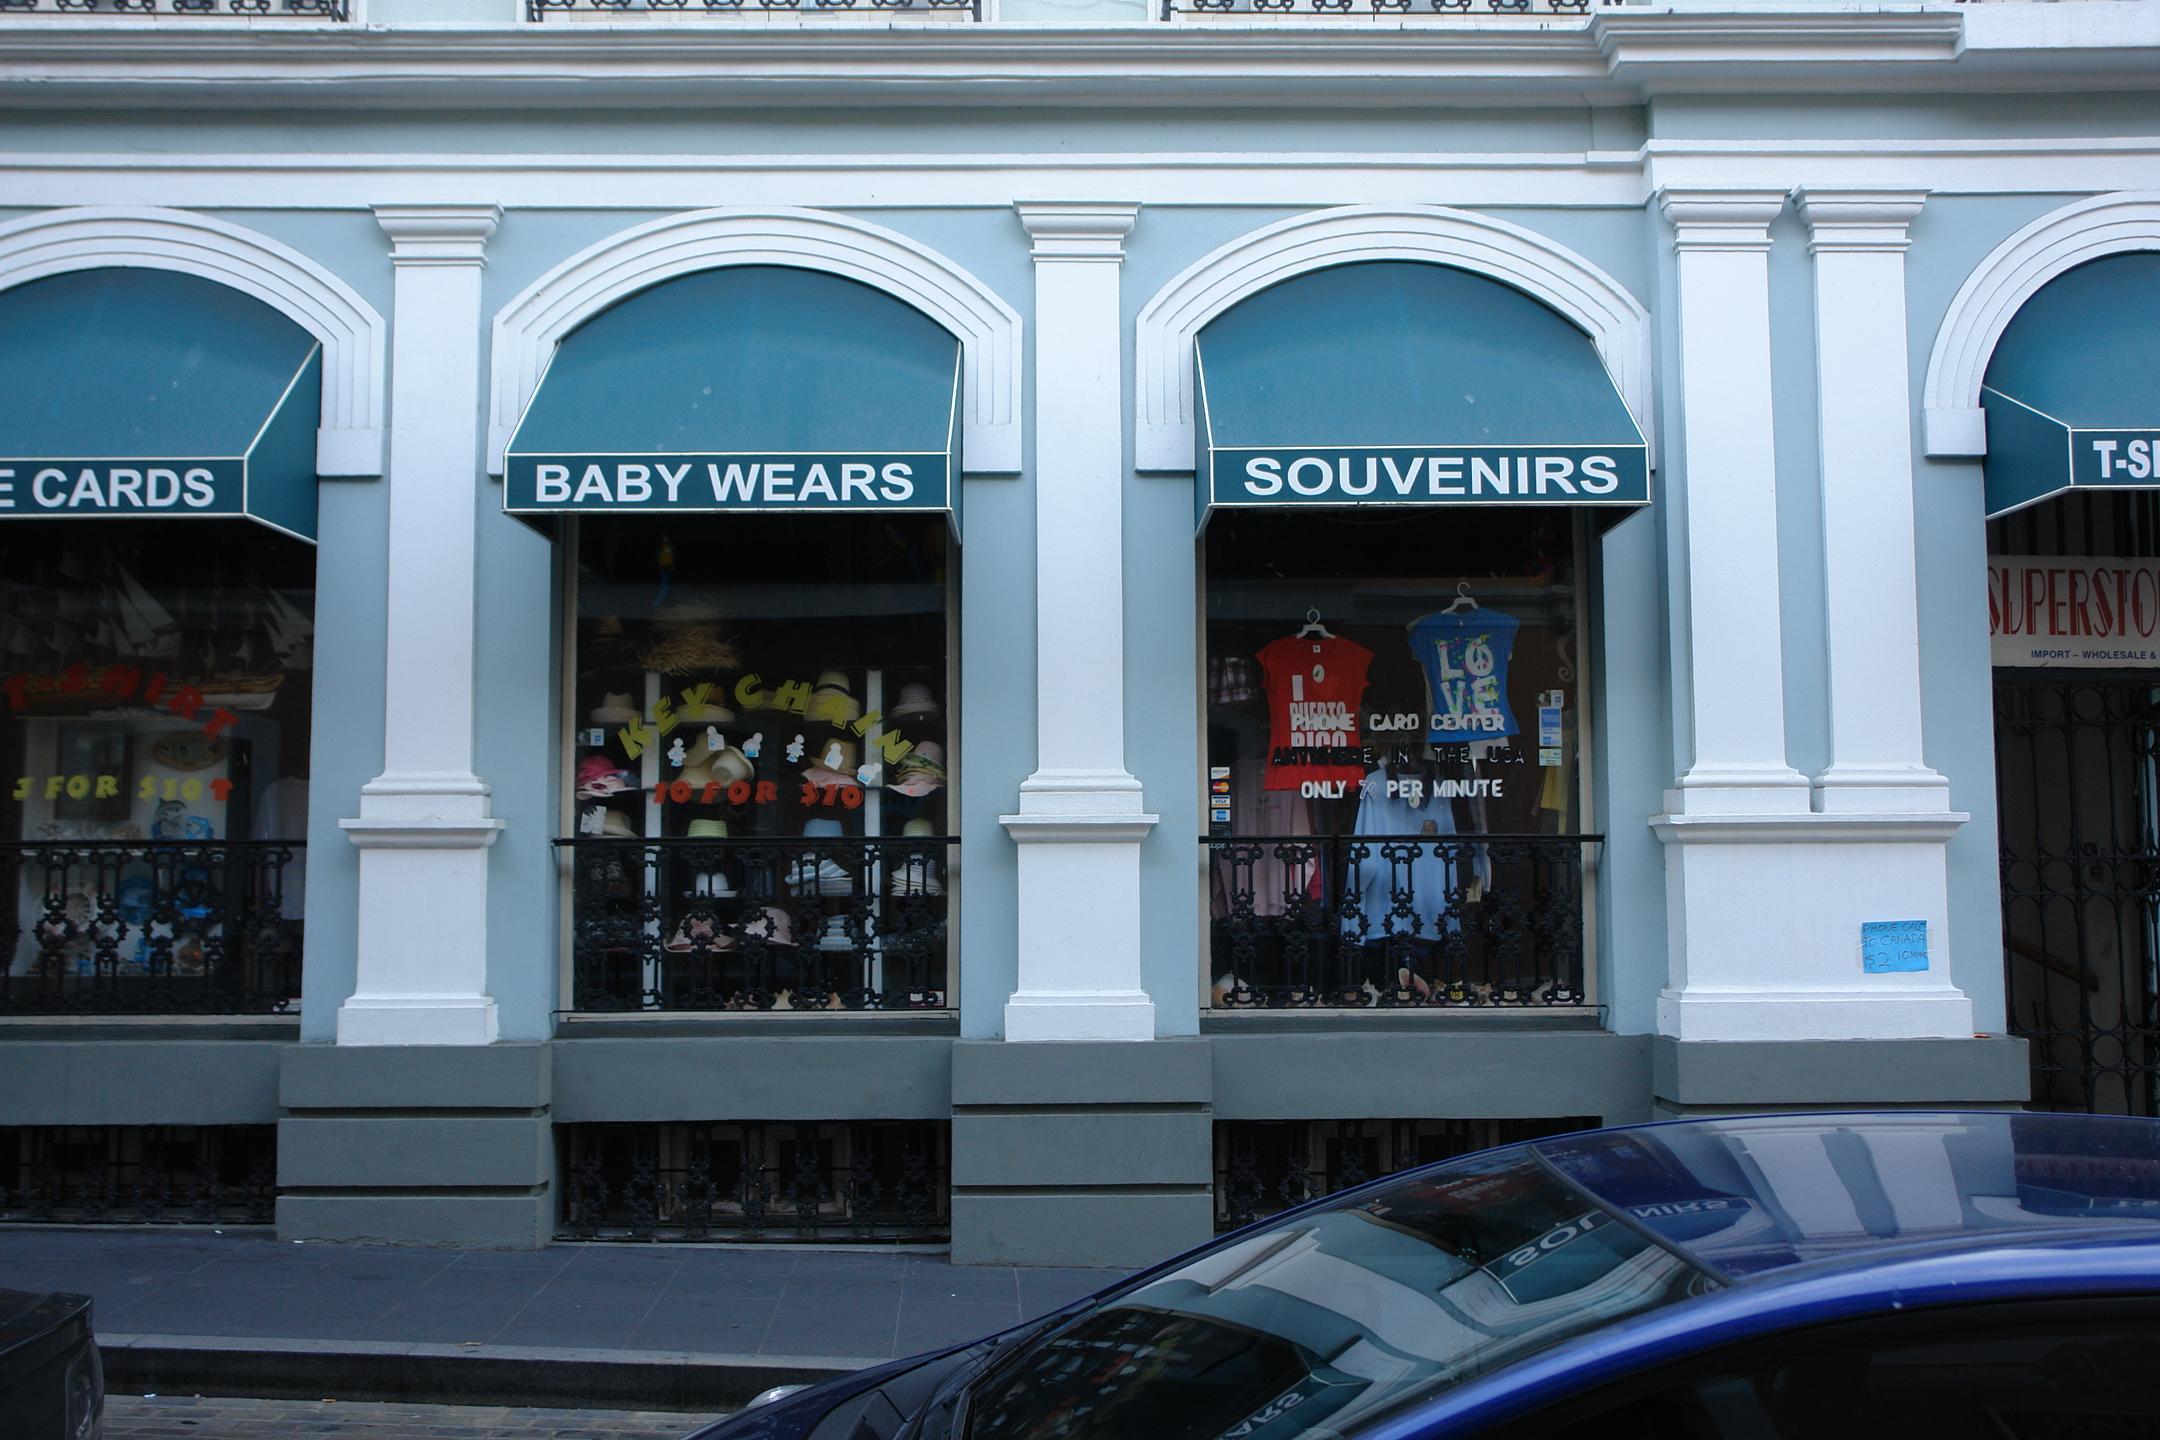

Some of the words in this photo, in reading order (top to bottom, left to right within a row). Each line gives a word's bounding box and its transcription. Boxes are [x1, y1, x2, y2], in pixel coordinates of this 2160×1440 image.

[1244, 456, 1619, 496] SOUVENIRS
[2092, 440, 2160, 479] T-S
[32, 468, 216, 508] CARDS
[536, 464, 692, 502] BABY
[707, 463, 915, 502] WEARS
[1988, 567, 2160, 638] SUPERSTO
[2031, 650, 2070, 659] IMPORT
[2082, 650, 2148, 661] WHOLESALE
[617, 682, 717, 761] KEY
[1369, 713, 1420, 731] CARD
[1431, 713, 1505, 731] CENTER
[44, 774, 119, 800] FOR
[653, 780, 694, 806] 10
[700, 780, 779, 806] FOR
[1301, 780, 1347, 799] ONLY
[1386, 779, 1424, 798] PER
[1433, 778, 1504, 798] MINUTE
